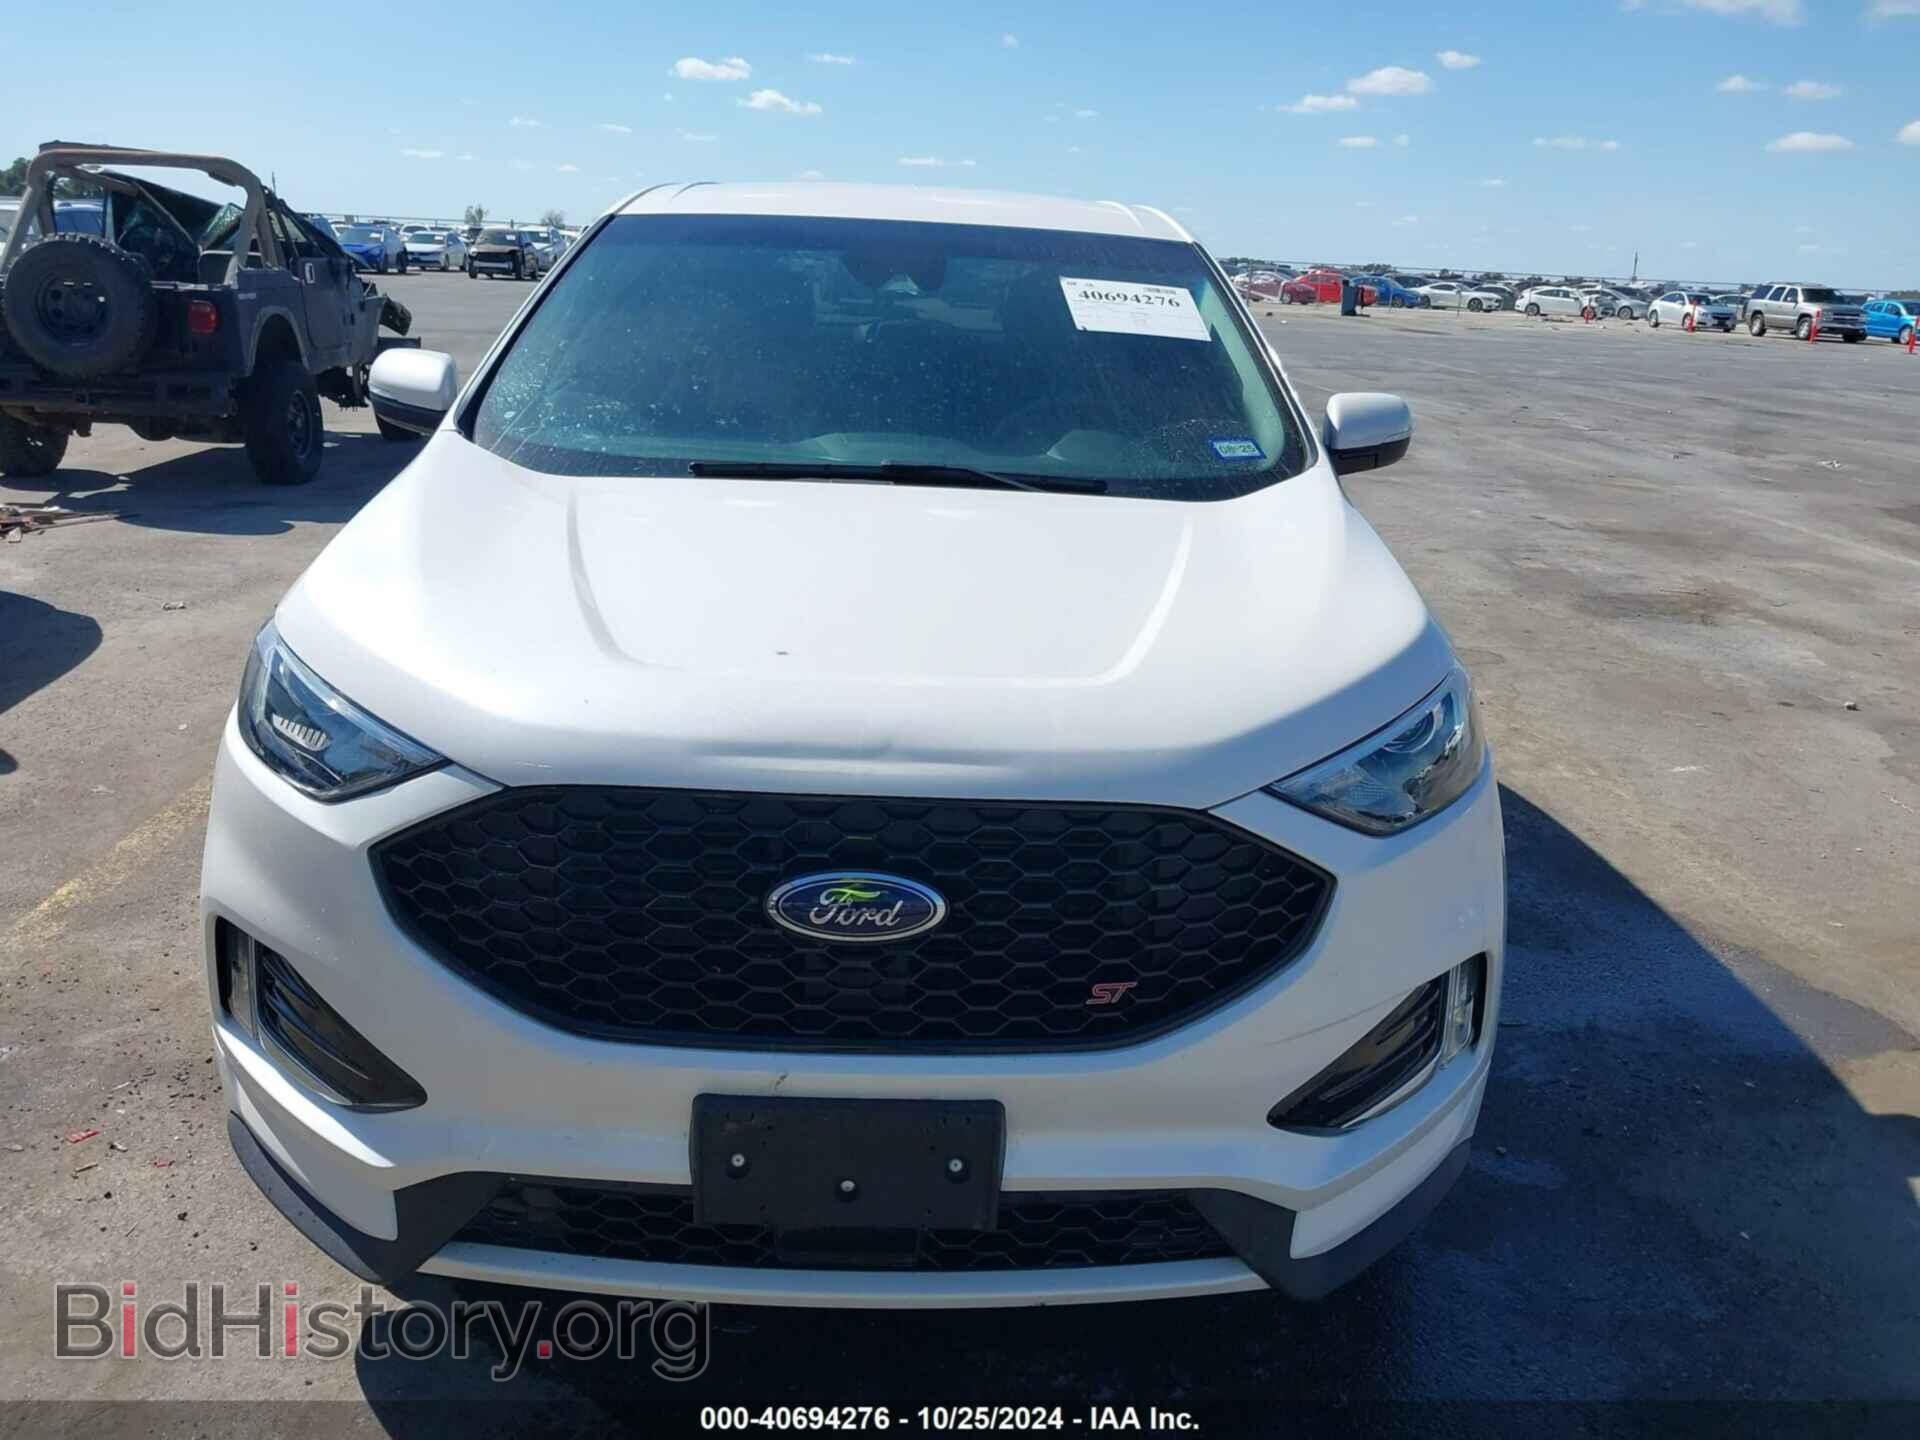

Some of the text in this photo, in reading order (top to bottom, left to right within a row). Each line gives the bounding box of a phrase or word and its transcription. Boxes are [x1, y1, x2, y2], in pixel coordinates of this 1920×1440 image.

[1079, 290, 1181, 308] 40694276
[809, 886, 904, 926] Ford
[1085, 982, 1138, 1004] ST
